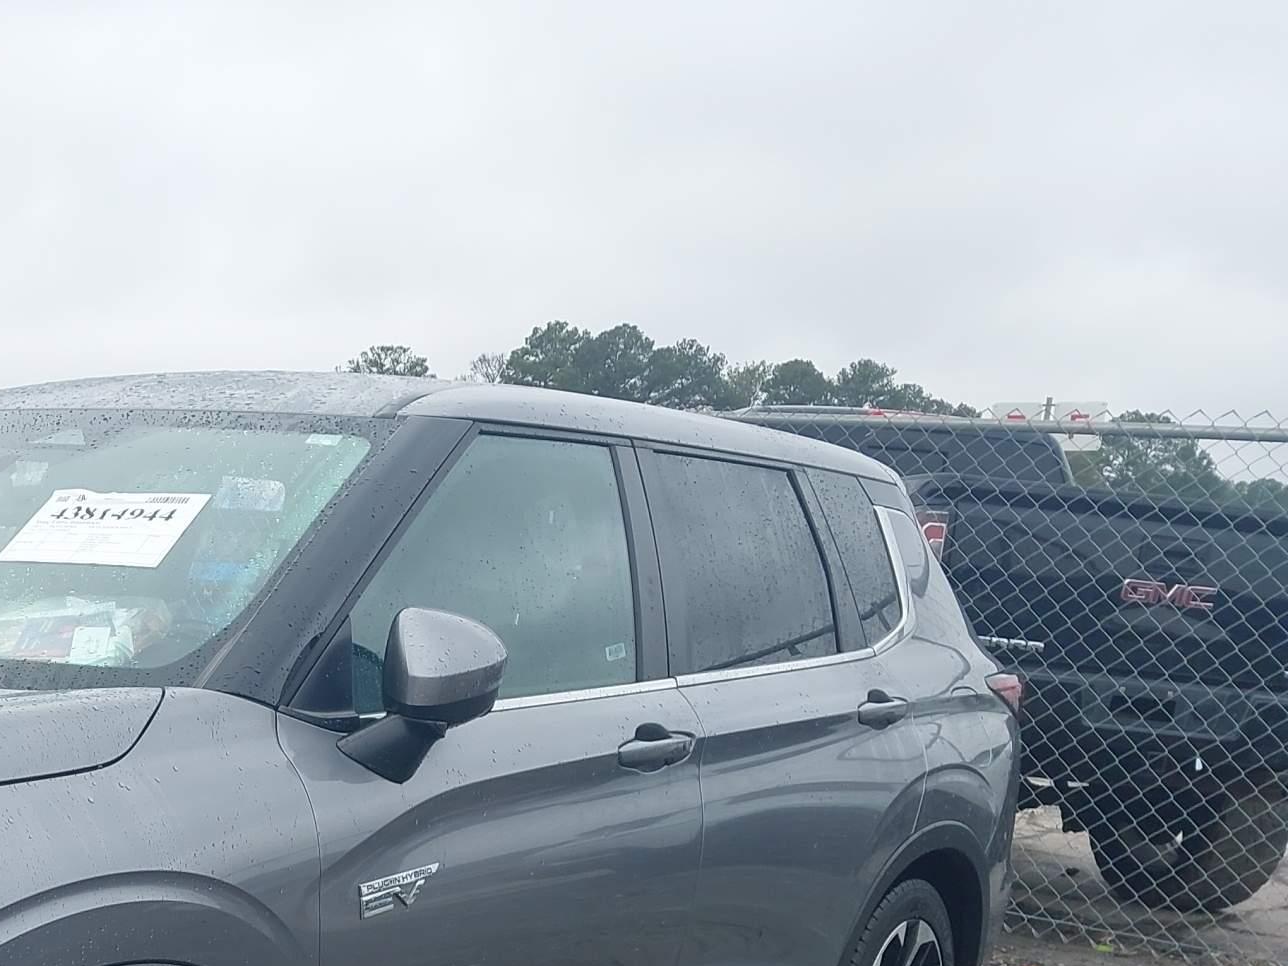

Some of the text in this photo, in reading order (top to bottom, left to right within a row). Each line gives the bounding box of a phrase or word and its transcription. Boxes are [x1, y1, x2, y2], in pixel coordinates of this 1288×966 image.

[50, 505, 178, 522] 43814944
[1120, 578, 1218, 609] GMC
[401, 867, 433, 883] HYBRID
[360, 879, 426, 919] EV
